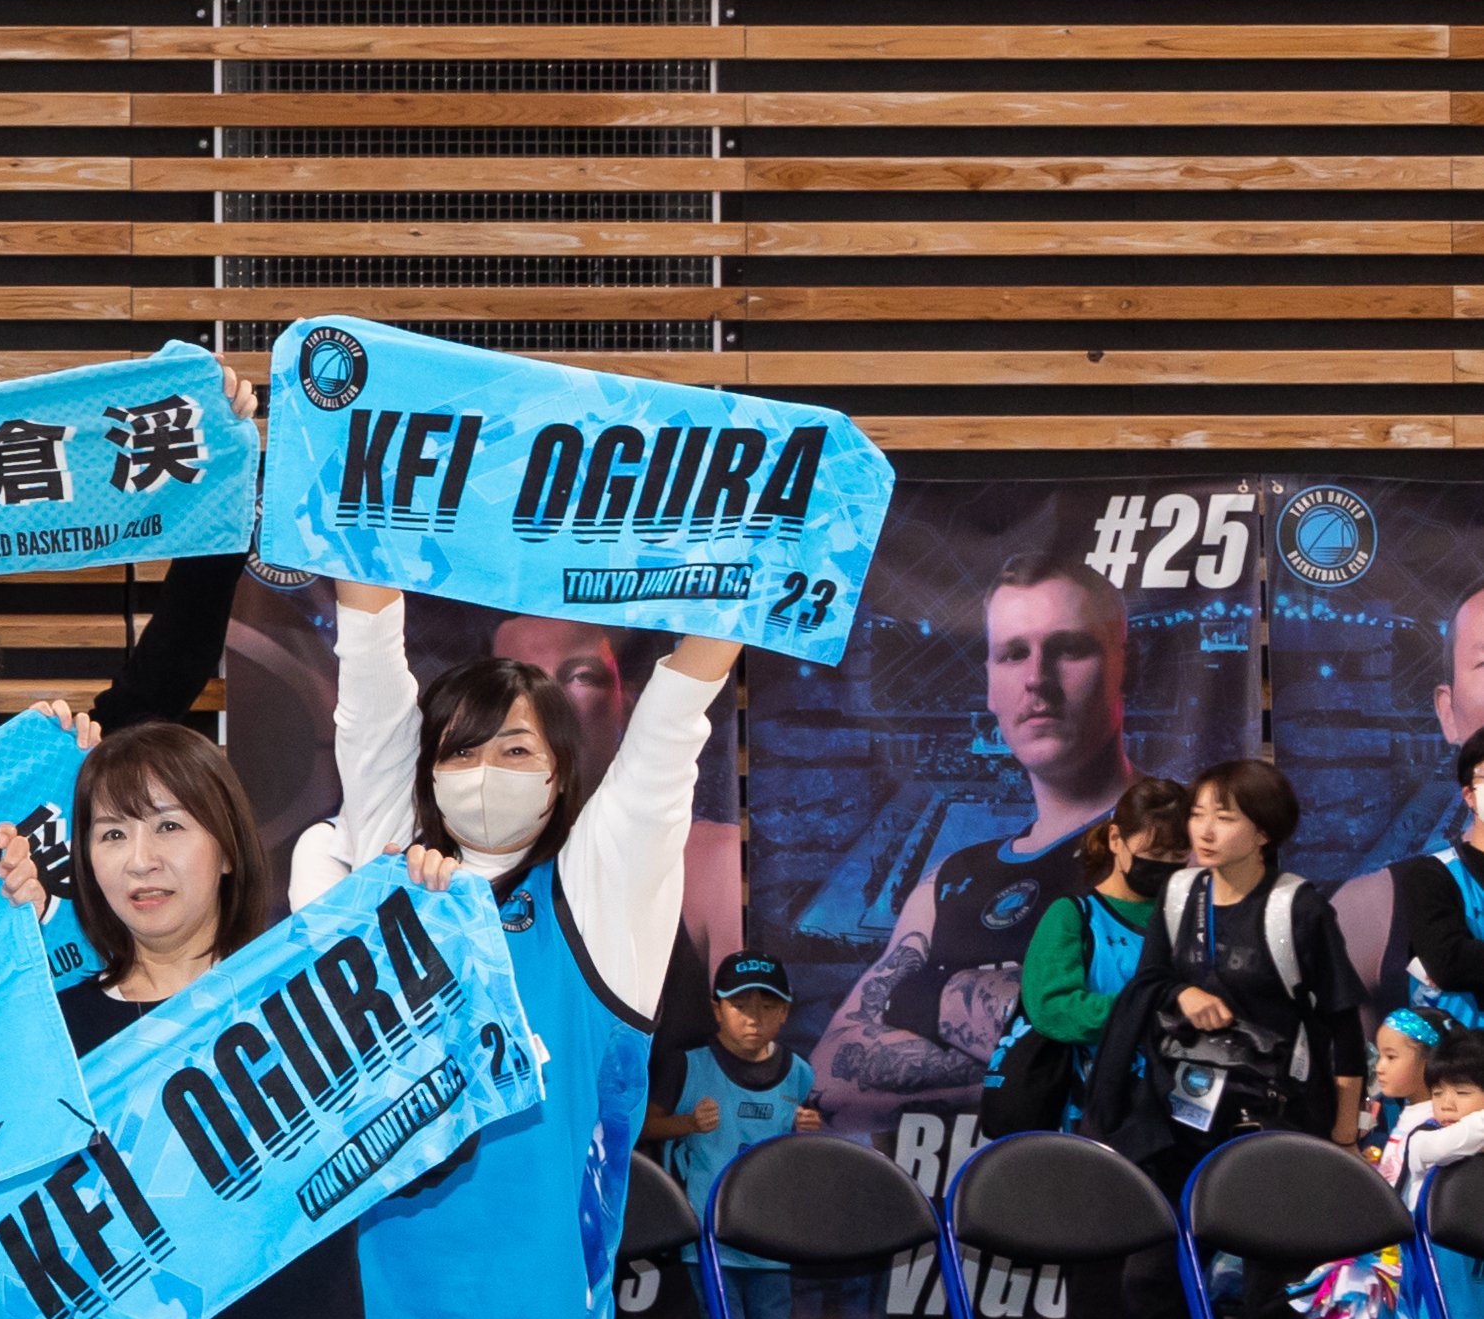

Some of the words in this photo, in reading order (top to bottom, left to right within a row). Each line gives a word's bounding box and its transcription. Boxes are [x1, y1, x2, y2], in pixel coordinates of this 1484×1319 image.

[102, 393, 203, 494] 渓
[510, 422, 829, 545] OGURA
[16, 525, 120, 560] BASKETBALL
[124, 513, 163, 539] CLUB
[1084, 493, 1256, 590] #25
[1289, 491, 1323, 518] TOKYO
[1327, 490, 1366, 520] UNITED
[566, 568, 637, 603] TOKYO
[638, 565, 716, 600] UNITED
[718, 564, 750, 598] BC
[766, 570, 838, 634] 23
[1286, 551, 1347, 581] BASKETBALL
[1347, 550, 1369, 574] CLUB
[161, 885, 467, 1201] OGURA
[298, 1148, 364, 1221] TOKYO
[363, 1092, 439, 1172] UNITED
[433, 1058, 466, 1112] BC
